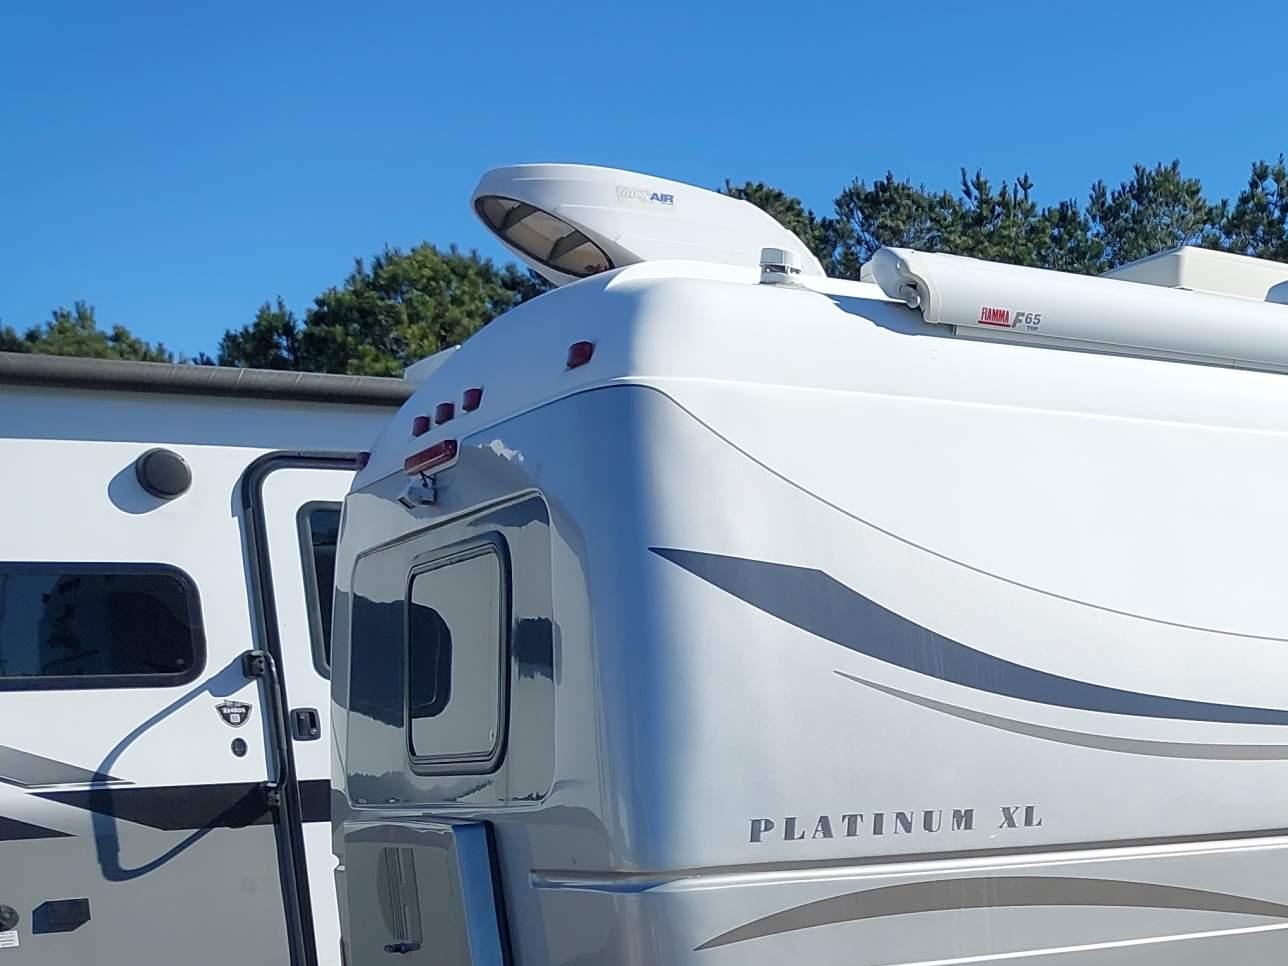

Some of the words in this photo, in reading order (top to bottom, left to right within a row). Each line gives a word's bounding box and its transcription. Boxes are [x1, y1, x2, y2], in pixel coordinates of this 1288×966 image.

[981, 307, 1010, 324] FIAMMA
[749, 808, 975, 843] PLATINUM
[999, 805, 1043, 829] XL
